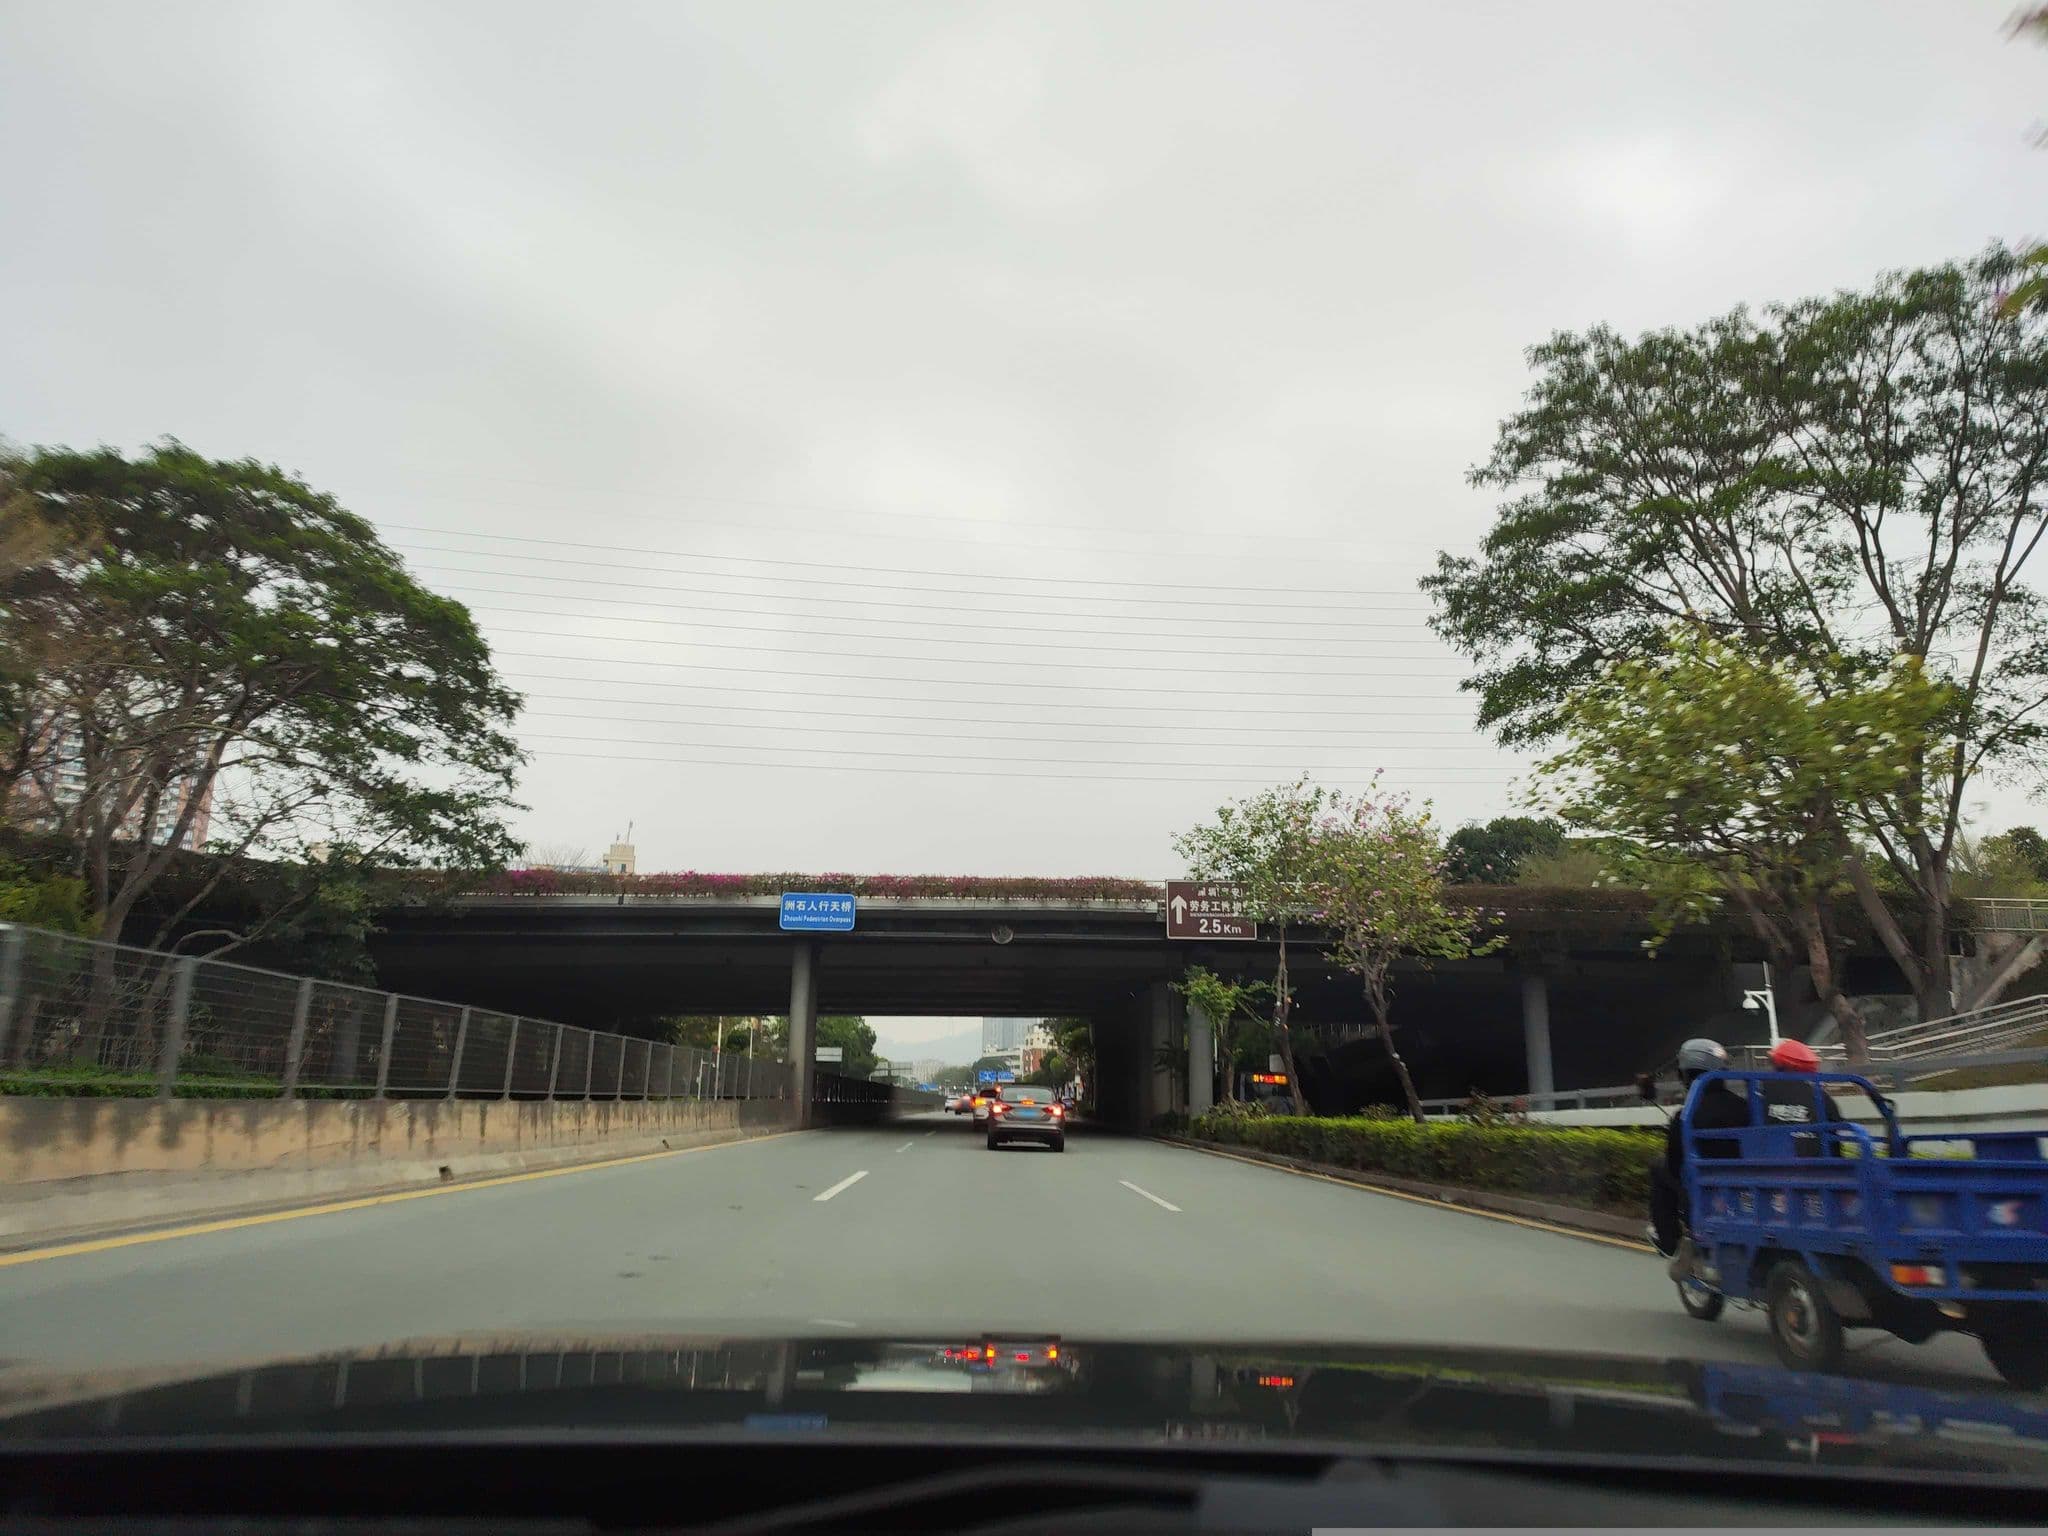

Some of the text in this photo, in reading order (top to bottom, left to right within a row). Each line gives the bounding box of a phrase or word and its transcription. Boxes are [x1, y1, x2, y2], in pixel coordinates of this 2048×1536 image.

[784, 900, 852, 912] 洲石人行天桥
[1199, 919, 1222, 934] 2.5
